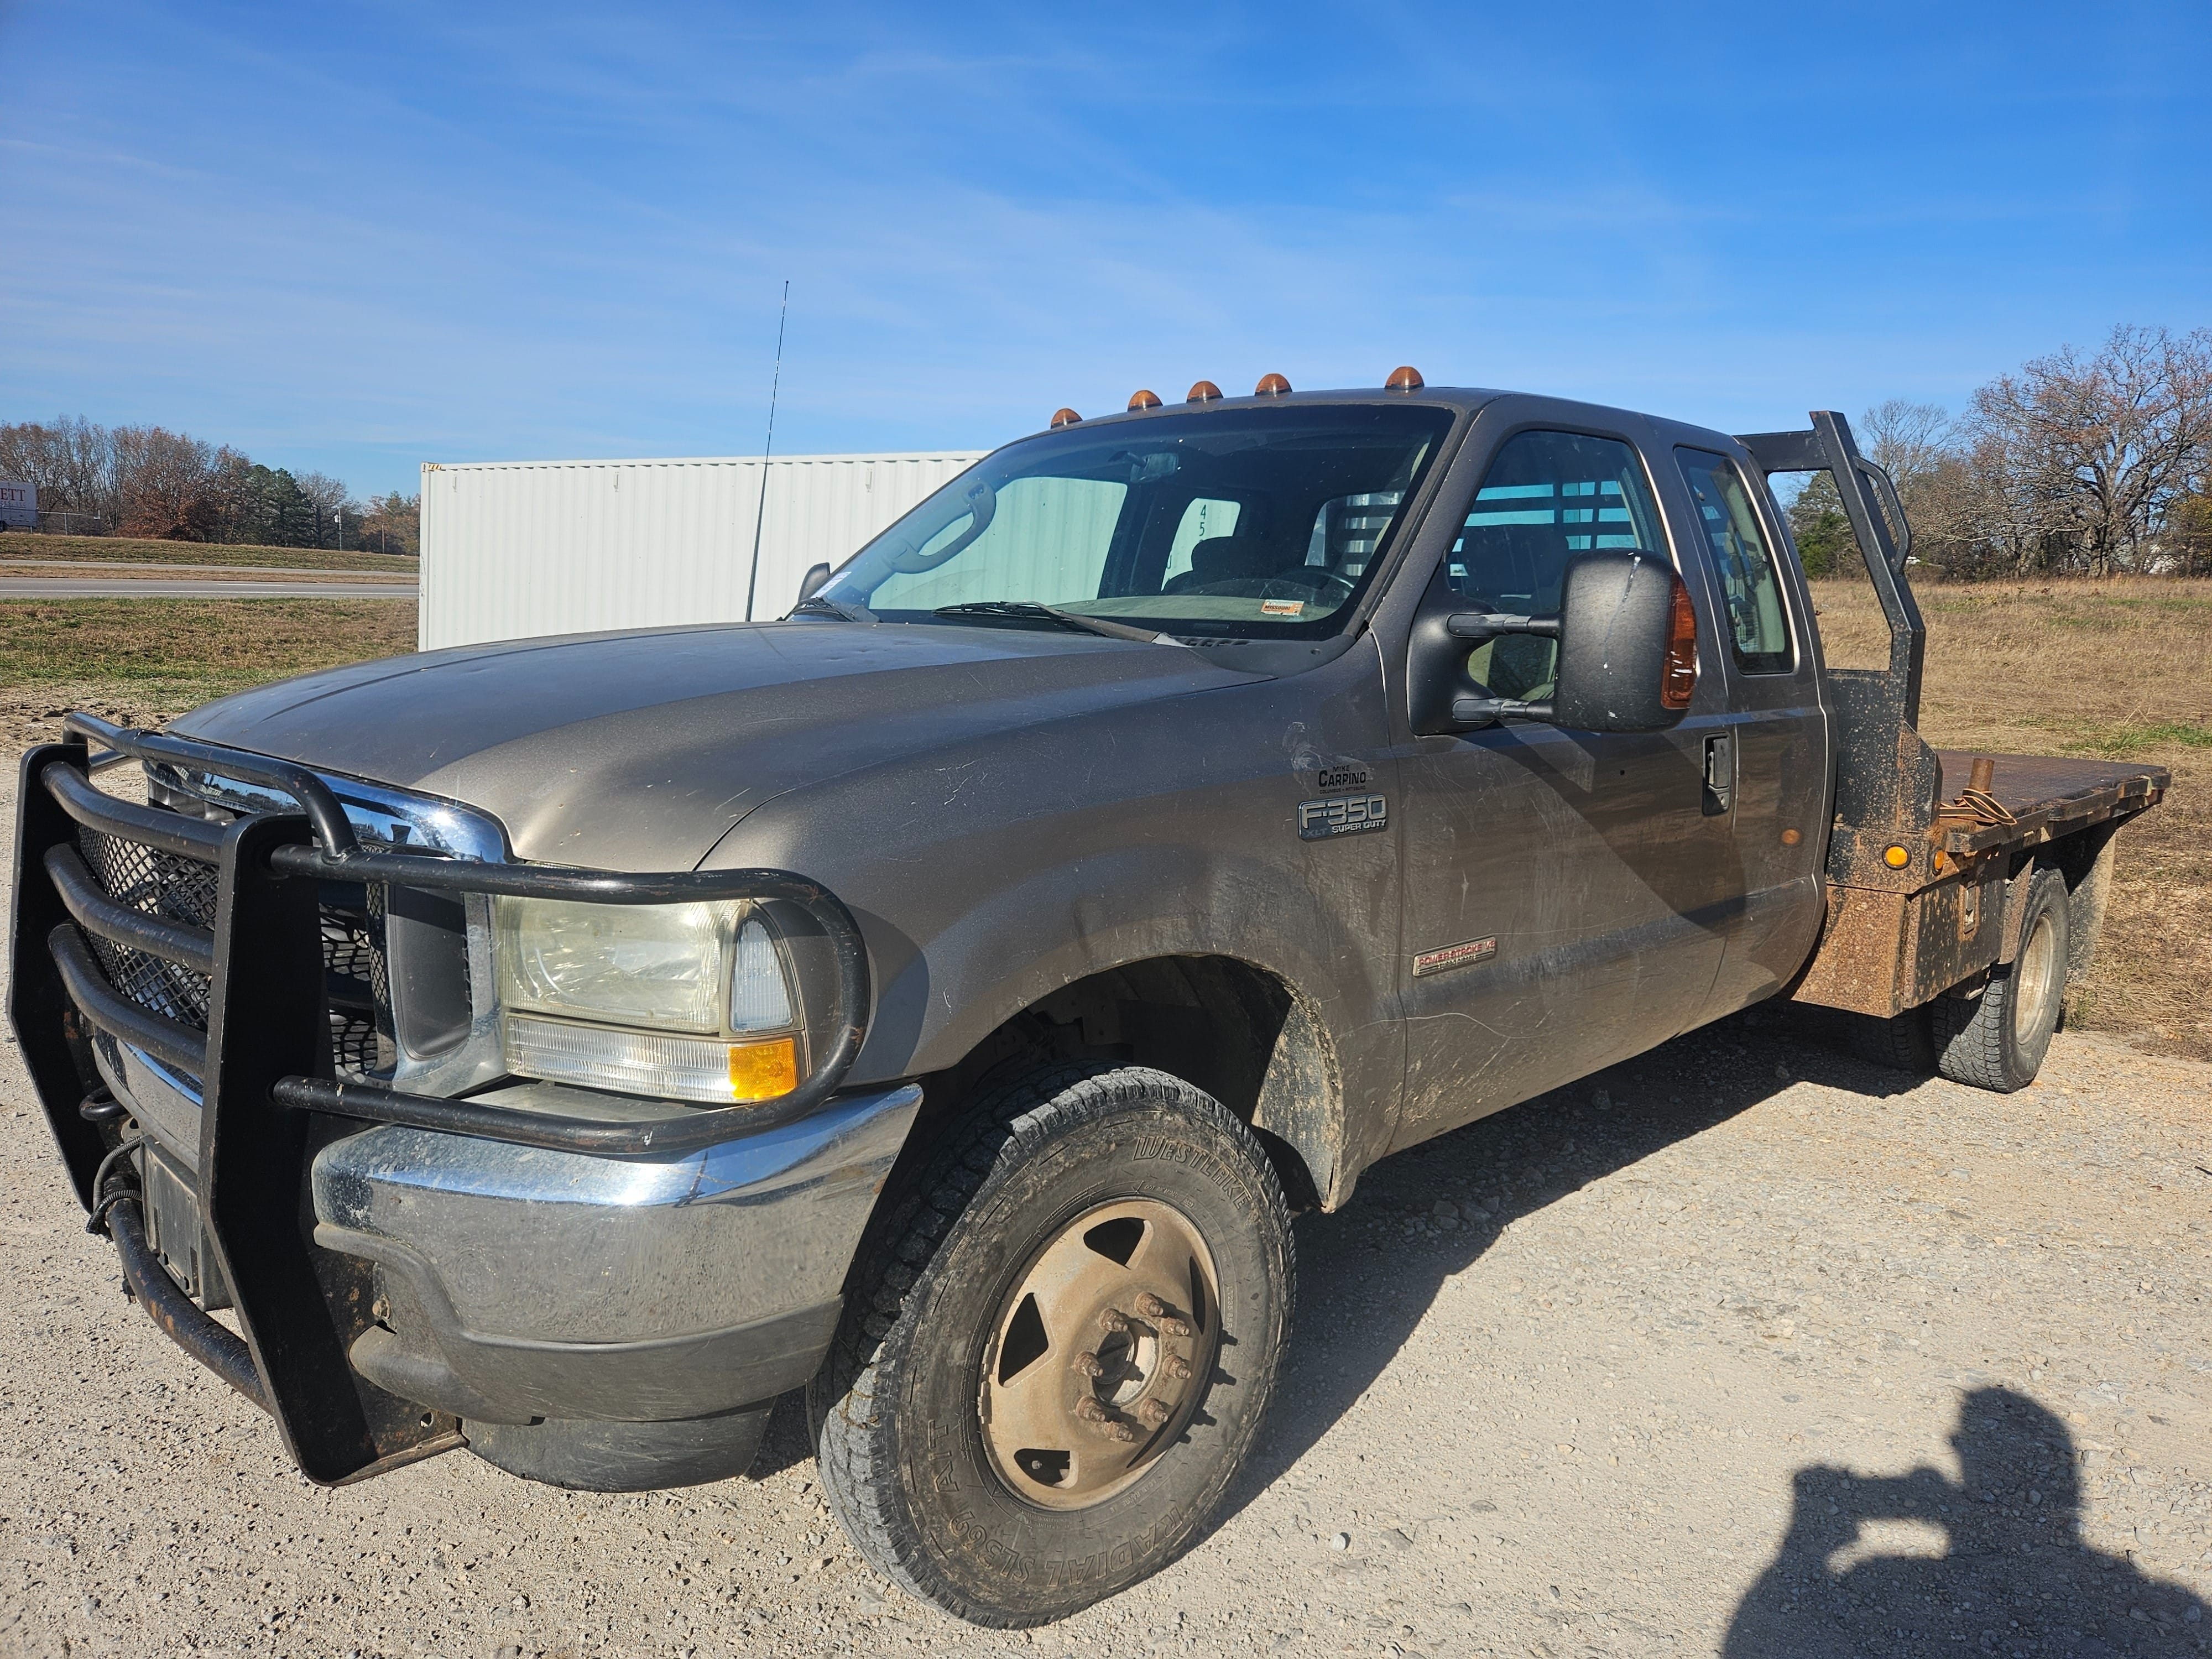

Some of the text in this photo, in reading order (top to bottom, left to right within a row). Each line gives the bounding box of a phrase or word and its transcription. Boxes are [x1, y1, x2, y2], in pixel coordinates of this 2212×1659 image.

[1332, 819, 1386, 833] SUPER DUTY
[1484, 940, 1496, 950] V8
[1133, 1136, 1254, 1211] WESTLAKE
[949, 1510, 1036, 1583] SL369
[1045, 1506, 1183, 1587] RADIAL
